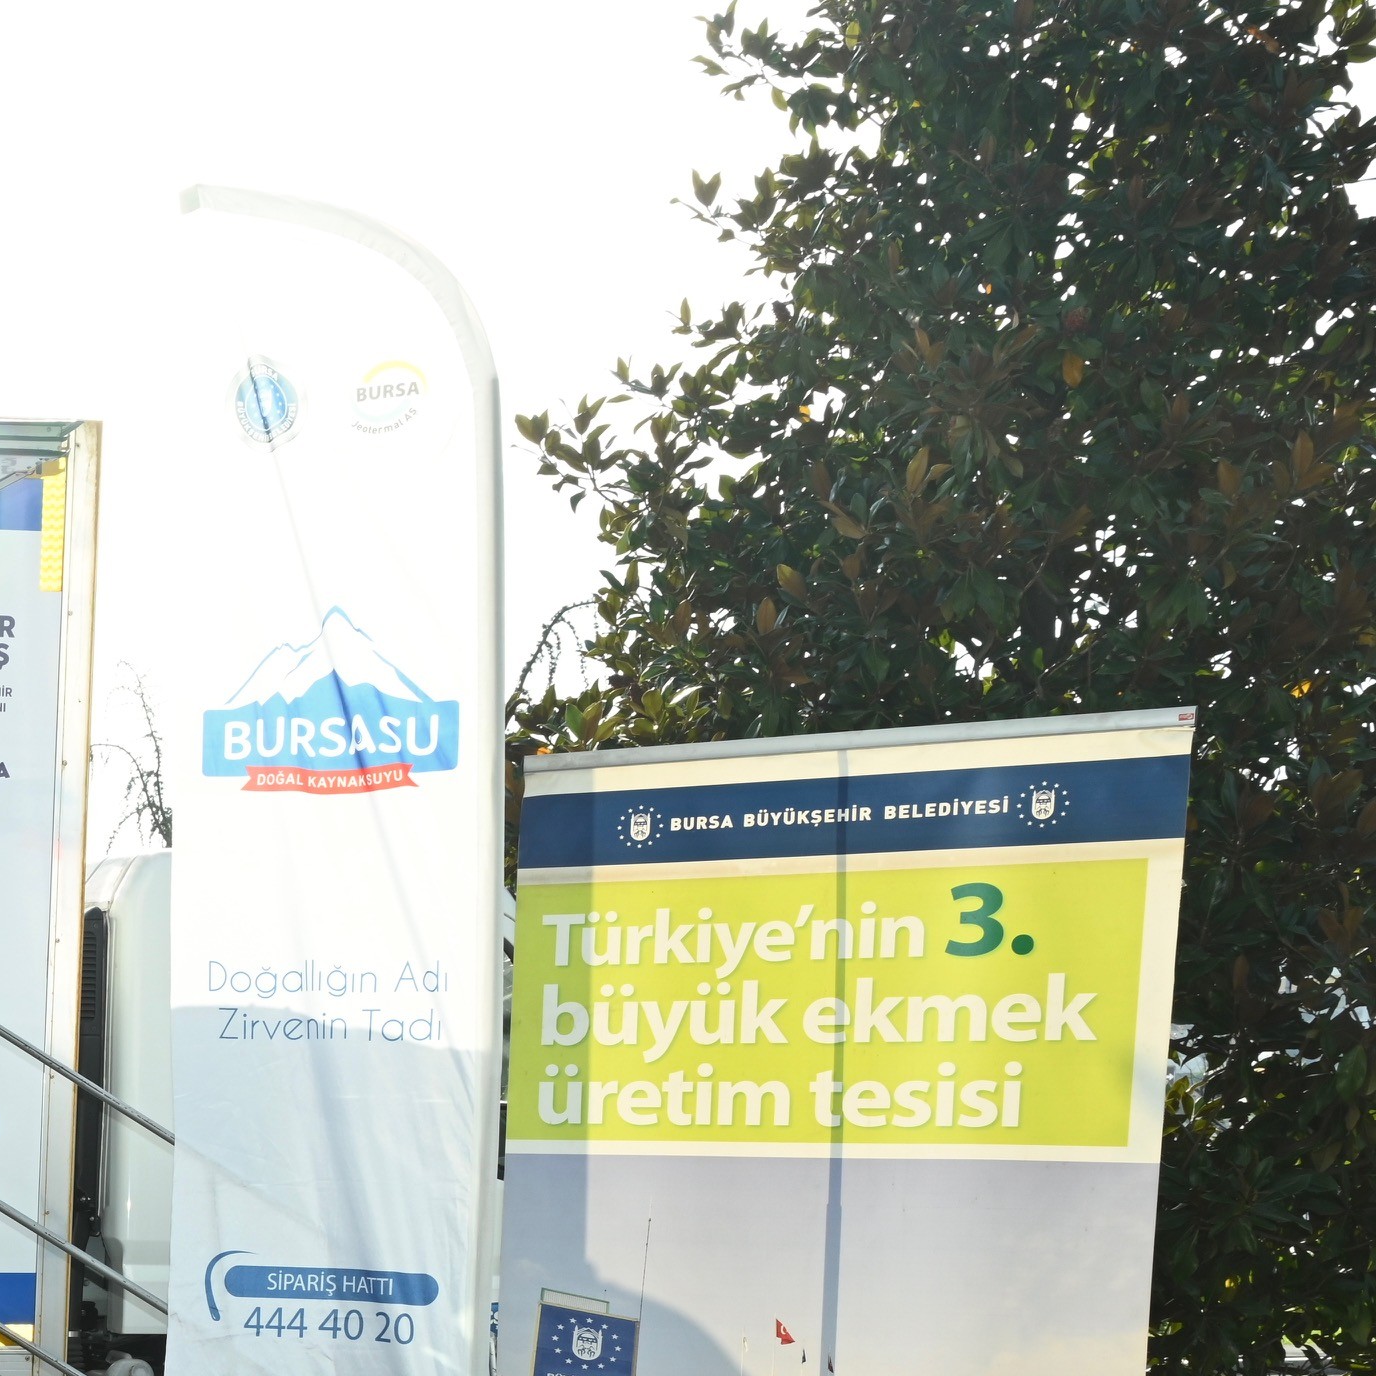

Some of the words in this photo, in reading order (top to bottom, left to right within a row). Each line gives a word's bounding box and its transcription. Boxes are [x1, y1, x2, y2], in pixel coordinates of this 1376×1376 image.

[356, 382, 420, 403] BURSA
[222, 714, 440, 761] BURSASU
[256, 771, 304, 786] DOĞAL
[670, 813, 734, 832] BURSA
[743, 804, 873, 828] BÜYÜKŞEHİR
[884, 795, 1010, 820] BELEDİYESİ
[541, 901, 925, 979] Türkiye'nin
[944, 882, 1036, 957] 3.
[208, 960, 378, 999] Doğallığın
[394, 960, 450, 994] Adı
[218, 1008, 348, 1042] Zirvenin
[361, 1008, 443, 1042] Tadı
[540, 980, 789, 1063] büyük
[802, 972, 1097, 1046] ekmek
[537, 1062, 790, 1127] üretim
[810, 1061, 1023, 1129] tesisi
[266, 1267, 337, 1297] SİPARİŞ
[342, 1276, 394, 1296] HATTI
[244, 1306, 308, 1339] 444
[318, 1308, 364, 1341] 40
[374, 1311, 415, 1346] 20
